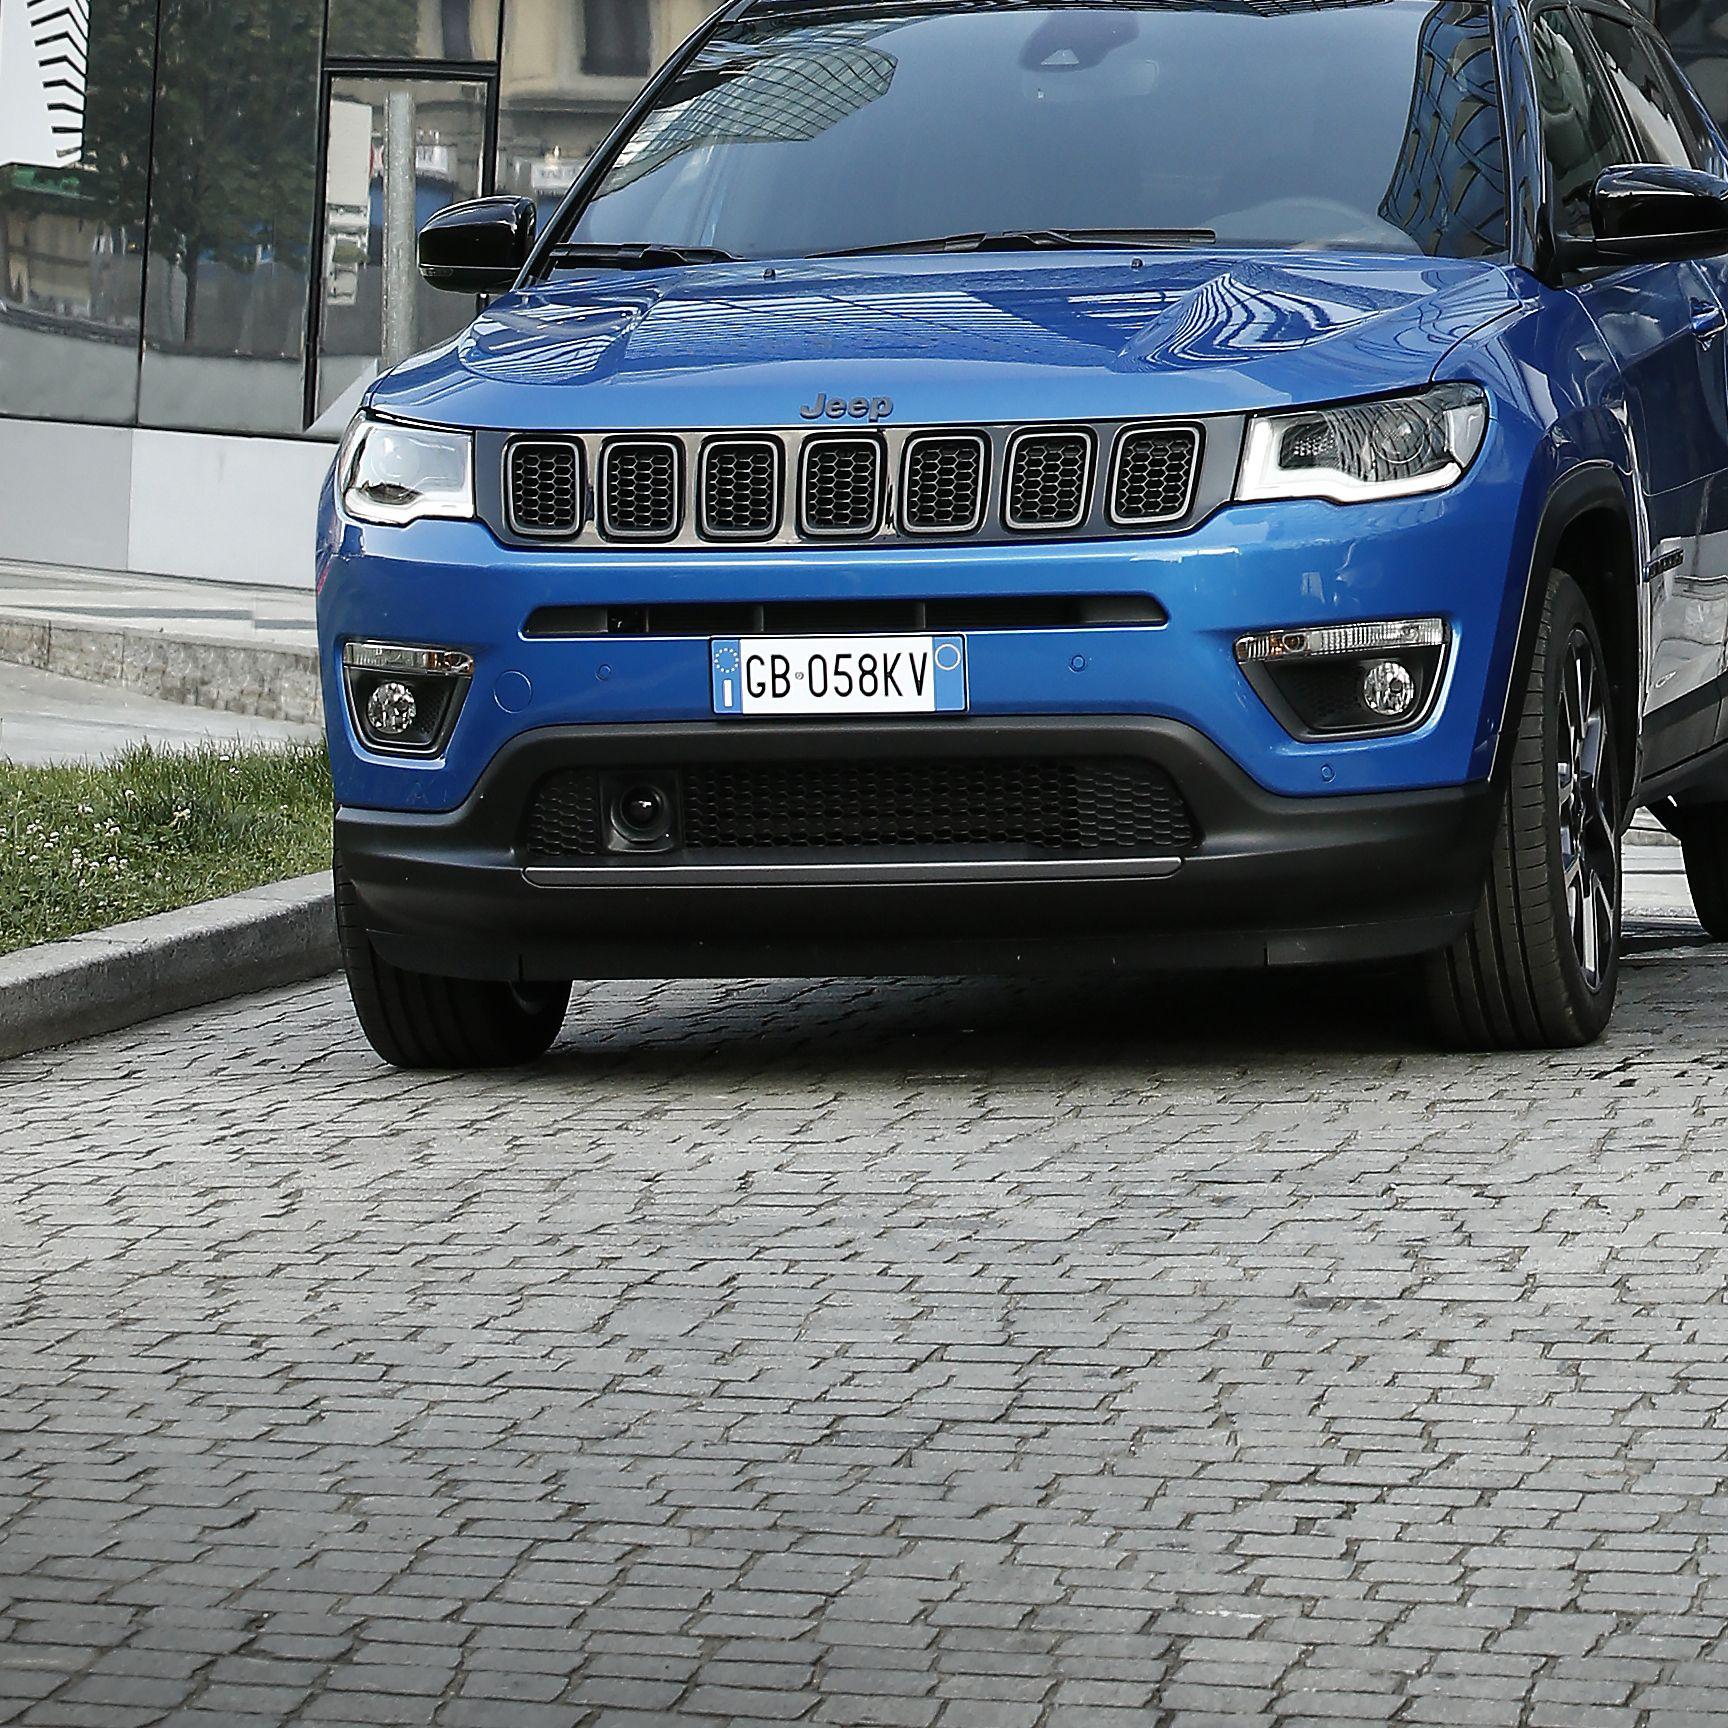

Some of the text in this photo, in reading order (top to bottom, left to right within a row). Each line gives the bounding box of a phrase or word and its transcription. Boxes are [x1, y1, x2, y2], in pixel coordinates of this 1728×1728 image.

[799, 391, 894, 423] Jeep
[745, 651, 929, 698] GB 058KV
